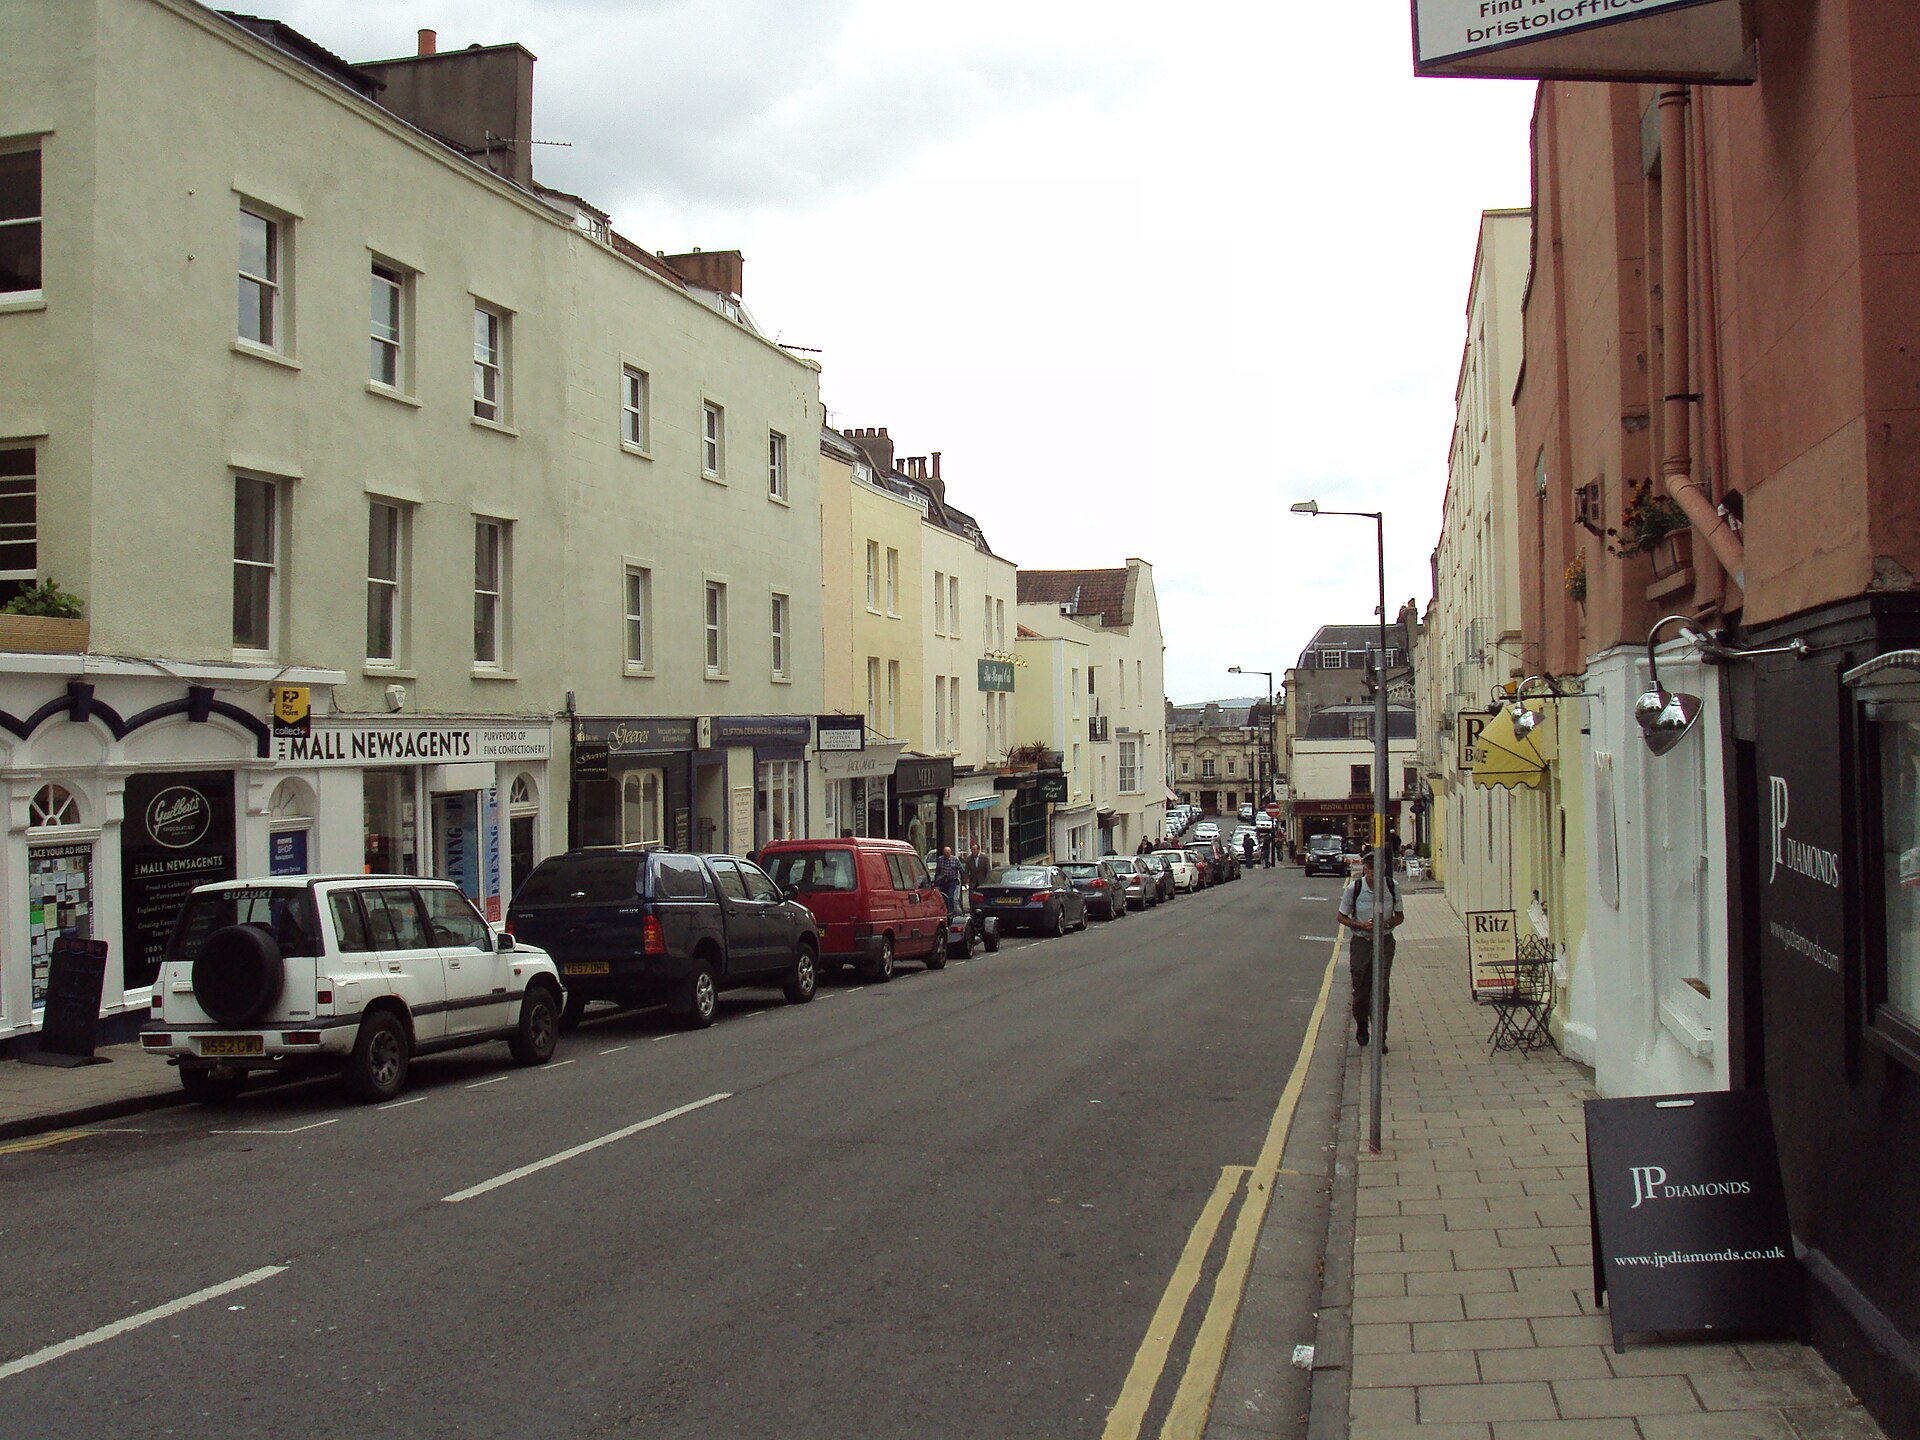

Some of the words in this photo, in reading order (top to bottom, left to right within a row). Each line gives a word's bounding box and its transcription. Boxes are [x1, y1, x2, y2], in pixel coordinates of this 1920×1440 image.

[291, 730, 345, 760] MALL
[352, 731, 471, 759] NEWSAGENTS
[483, 731, 517, 742] PURVEYORS
[518, 731, 526, 741] OF
[483, 746, 498, 755] FINE
[498, 743, 545, 755] CONFECTIONERY
[1769, 775, 1789, 884] JP
[1786, 838, 1839, 888] DIAMONDS
[46, 848, 64, 857] YOUR
[64, 846, 74, 855] AD
[75, 844, 91, 854] HERE
[140, 861, 164, 875] MALL
[166, 855, 223, 872] NEWSAGENTS
[223, 890, 273, 900] SUZUKI
[1474, 915, 1510, 933] Ritz
[566, 962, 589, 974] YE57
[1629, 1165, 1667, 1209] JP
[1664, 1181, 1751, 1198] DIAMONDS
[1614, 1246, 1786, 1268] www.jpdiamonds.co.uk
